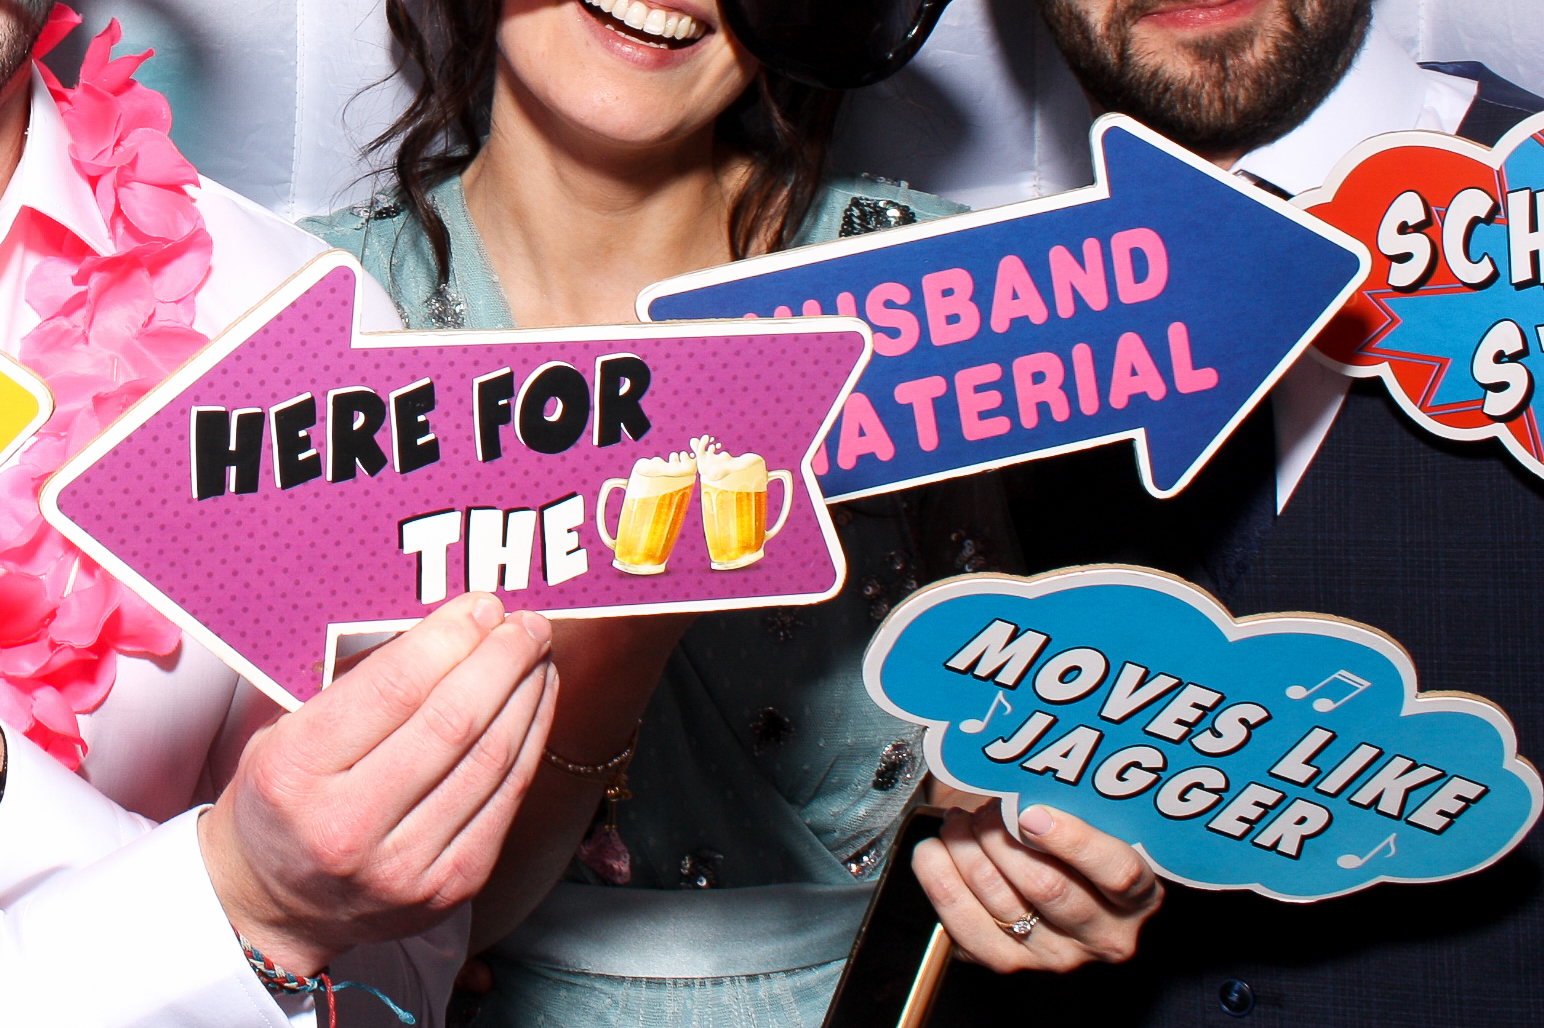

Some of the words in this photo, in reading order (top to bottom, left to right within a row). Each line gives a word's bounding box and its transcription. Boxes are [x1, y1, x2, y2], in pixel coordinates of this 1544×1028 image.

[742, 227, 1169, 357] SBAND
[191, 377, 441, 501] HERE
[473, 353, 652, 463] FOR
[812, 322, 1218, 476] ATERIAL
[398, 494, 589, 606] THE
[943, 619, 1271, 757] MOVES
[1268, 726, 1490, 834] LIKE
[982, 709, 1333, 860] JAGGER
